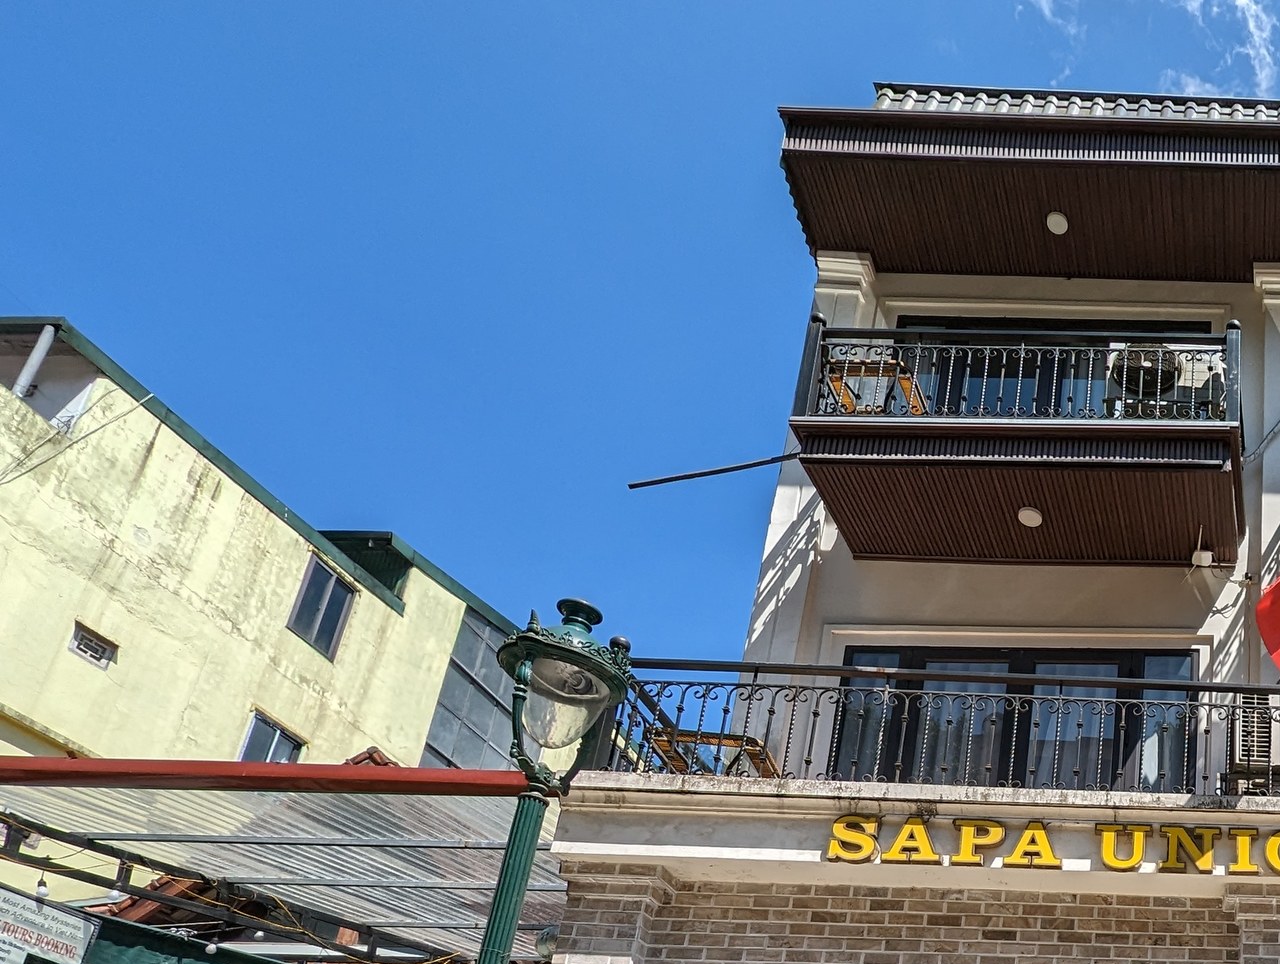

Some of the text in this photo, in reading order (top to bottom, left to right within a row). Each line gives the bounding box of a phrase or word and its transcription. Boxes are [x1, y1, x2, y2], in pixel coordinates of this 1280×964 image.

[826, 814, 1063, 870] SAPA
[1, 921, 34, 945] TOURS
[34, 933, 77, 959] BOOKING
